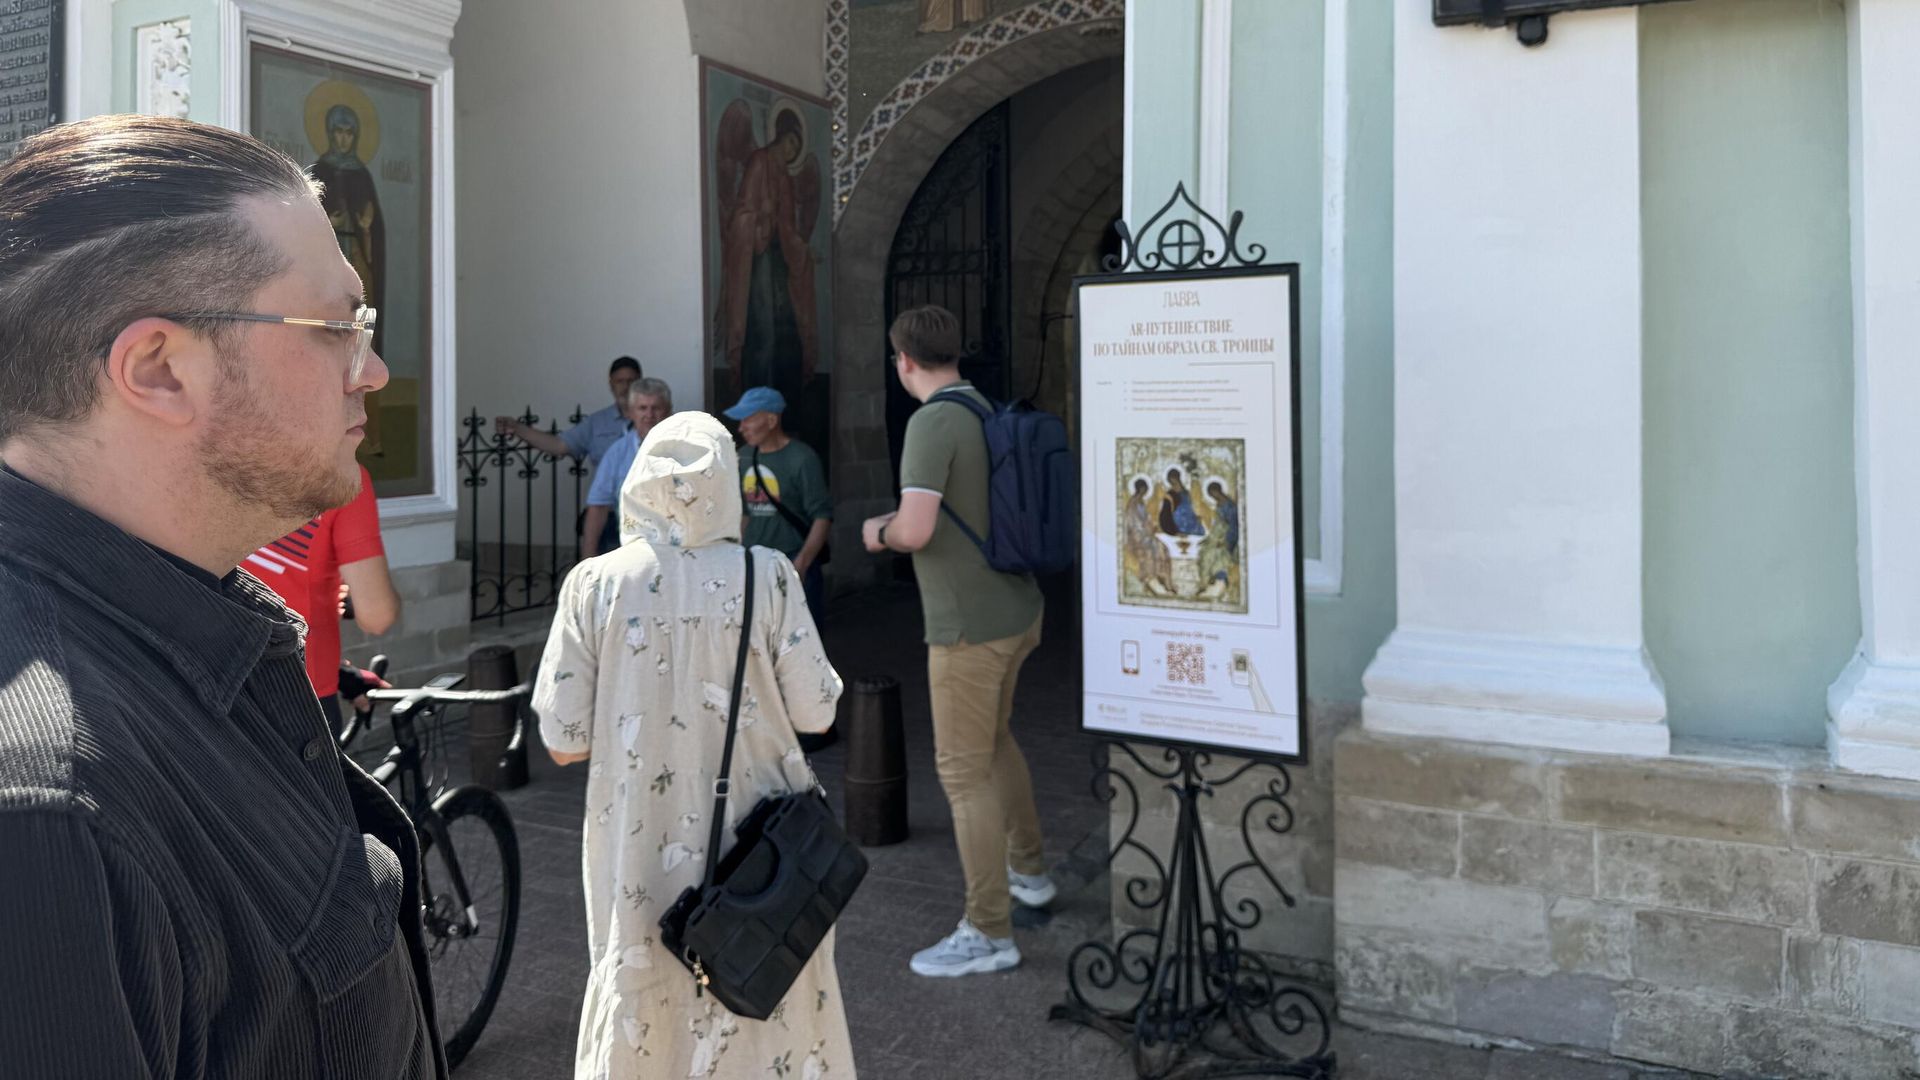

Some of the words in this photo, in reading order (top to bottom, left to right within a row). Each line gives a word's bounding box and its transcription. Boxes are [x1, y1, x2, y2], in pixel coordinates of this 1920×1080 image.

[1163, 290, 1201, 308] ЛАВРА
[1129, 319, 1233, 337] AR-ПУТЕШЕСТВИЕ
[1093, 343, 1110, 357] ПО
[1111, 339, 1156, 356] ТАЙНАМ
[1157, 341, 1200, 355] ОБРАЗА
[1201, 340, 1220, 354] СВ.
[1222, 338, 1275, 354] ТРОИЦЫ
